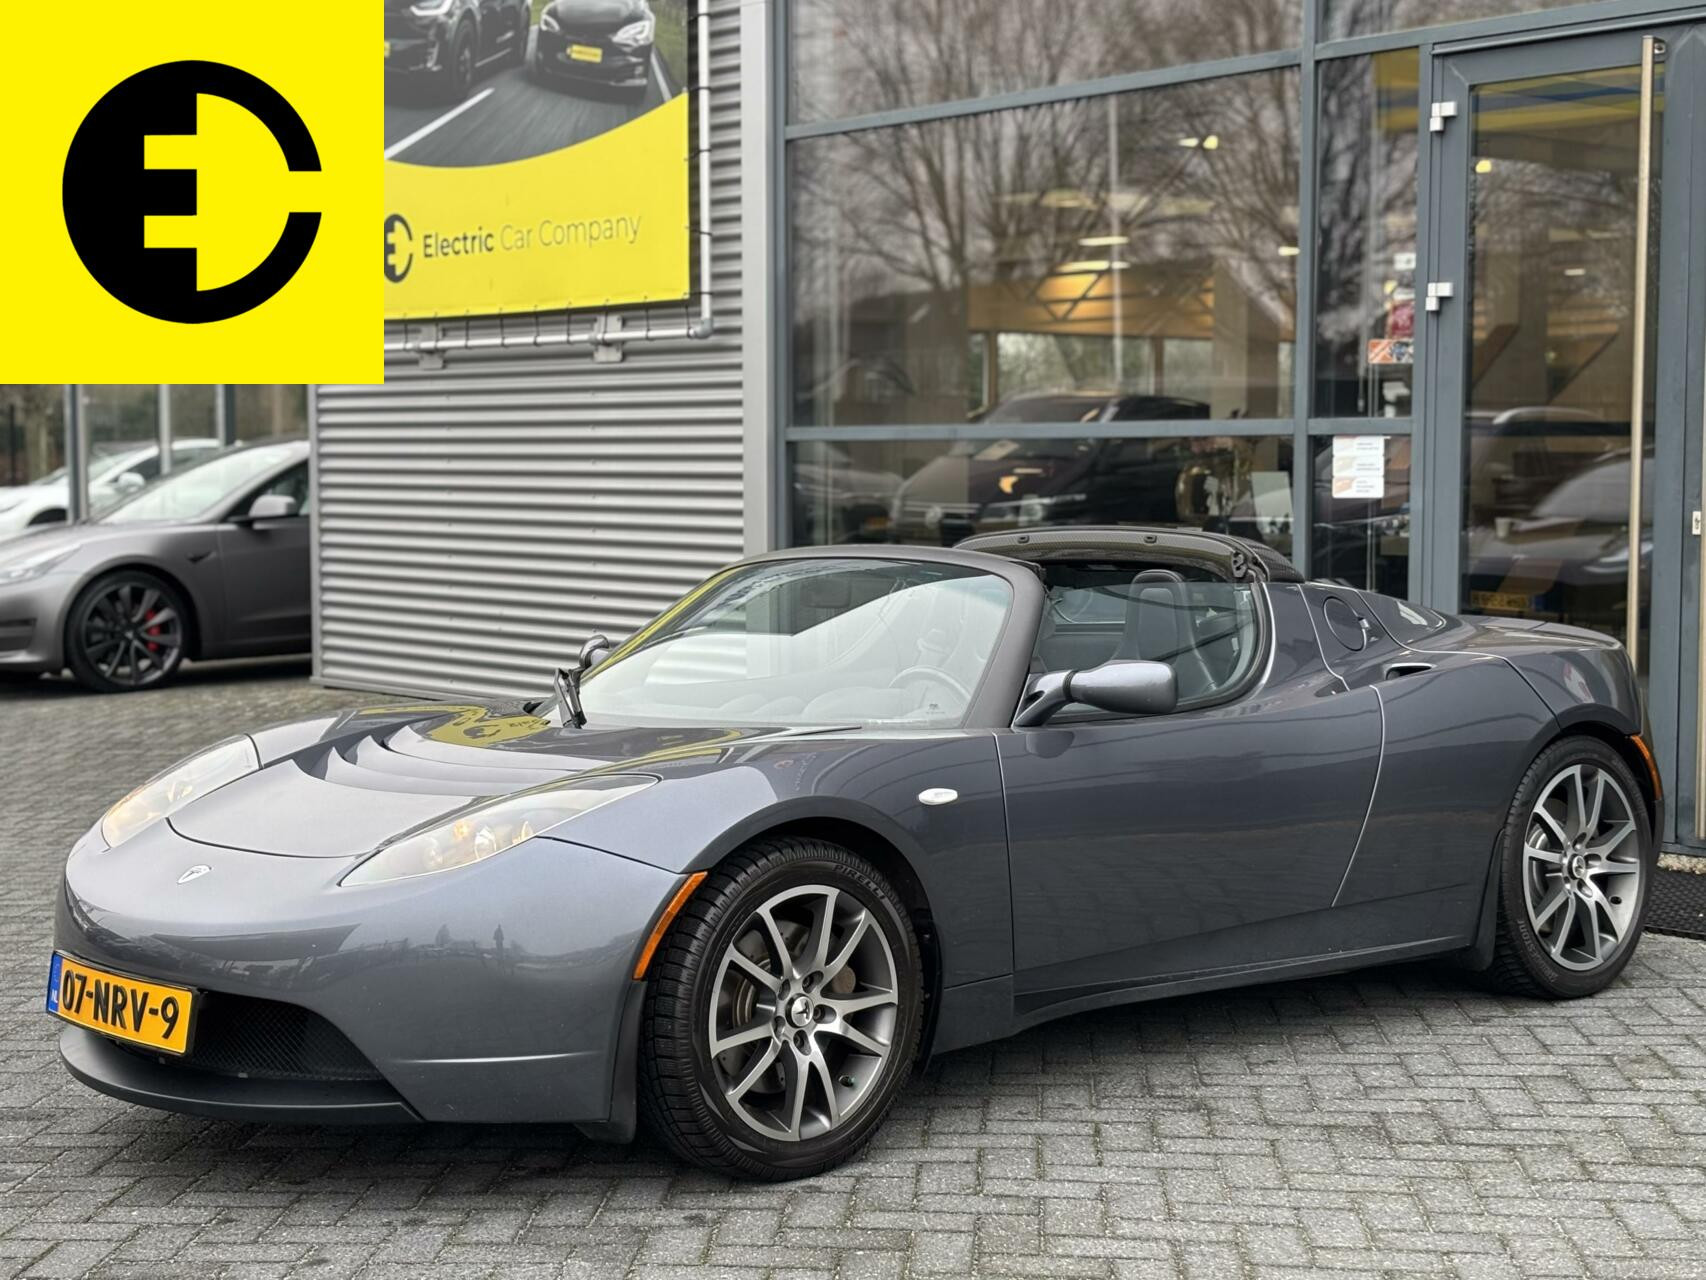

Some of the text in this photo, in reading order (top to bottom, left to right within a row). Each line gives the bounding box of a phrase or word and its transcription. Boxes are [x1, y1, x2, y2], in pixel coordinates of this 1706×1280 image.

[423, 215, 642, 258] Electric Car Company
[832, 864, 885, 899] PIRELLI
[62, 969, 180, 1040] 07-NRV-9
